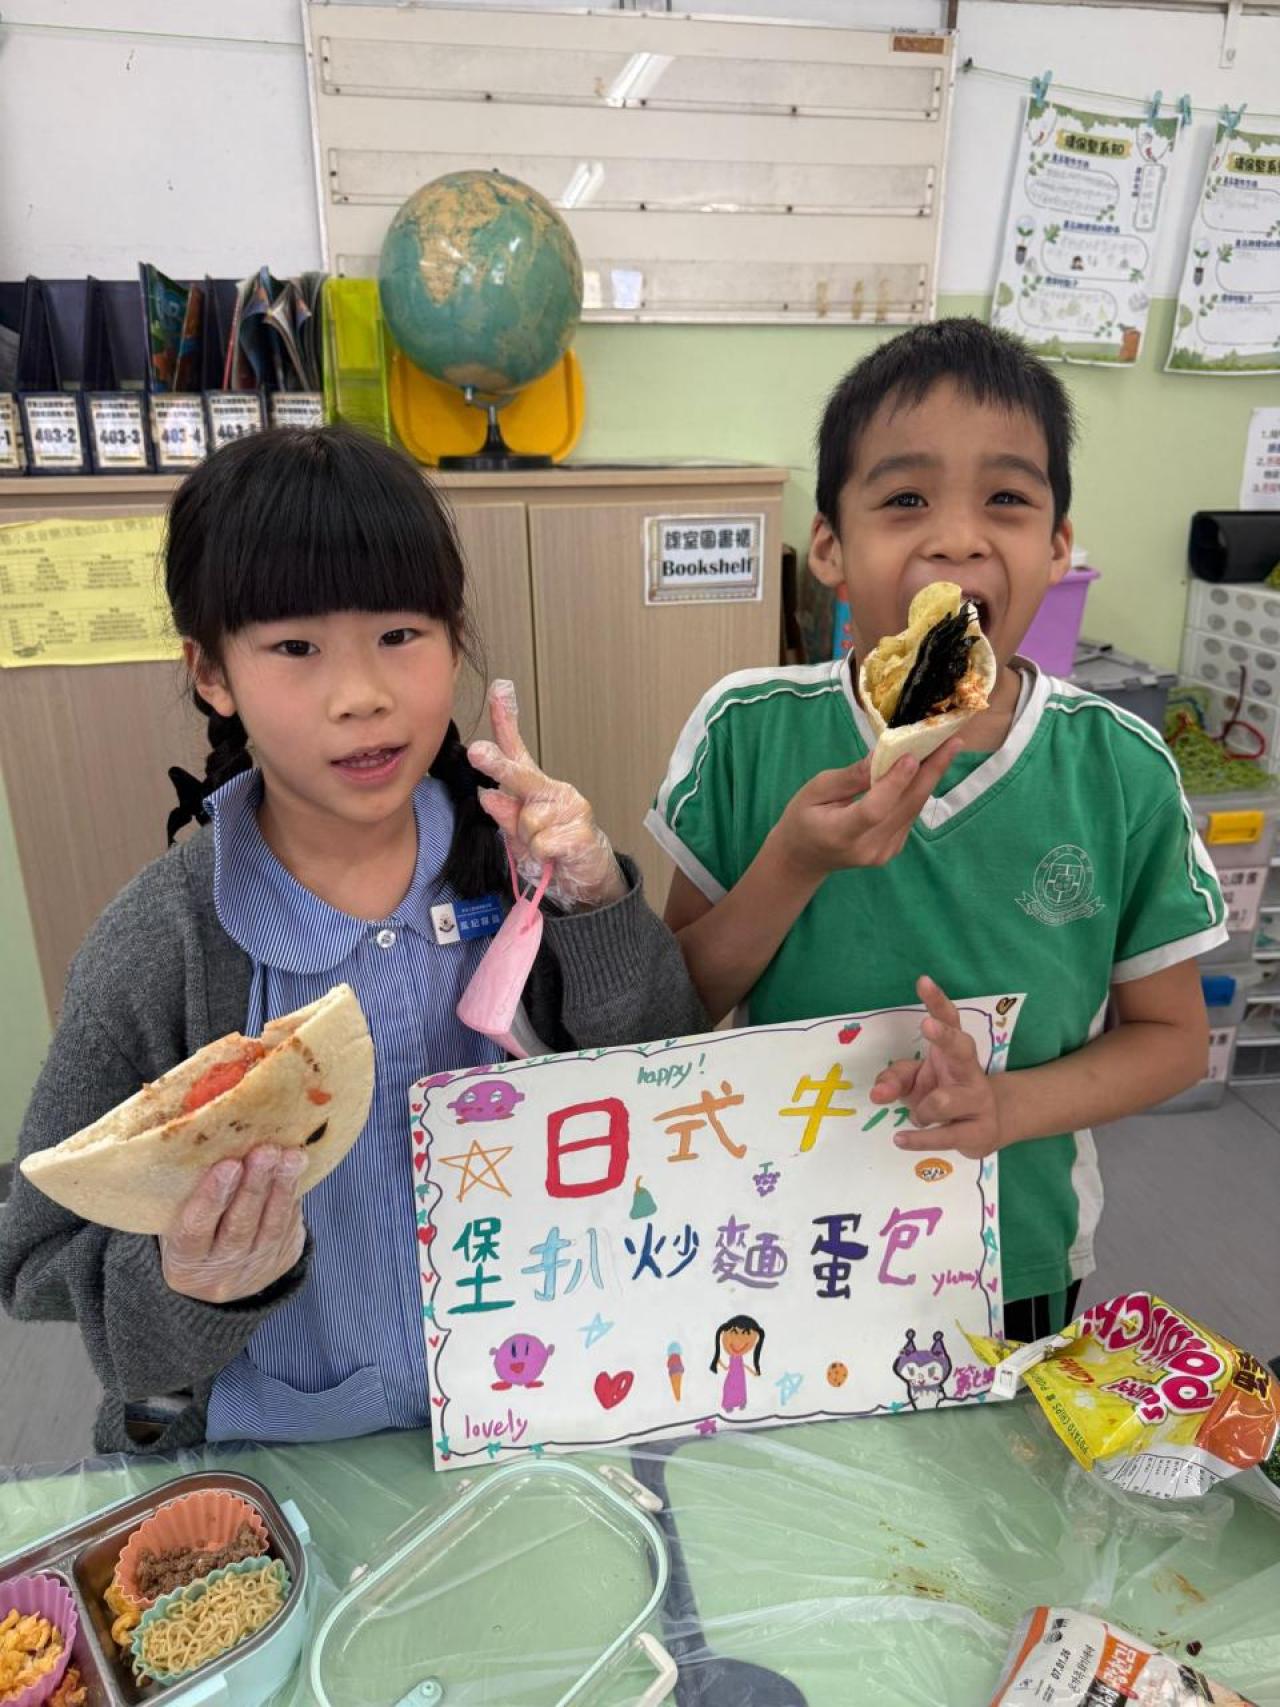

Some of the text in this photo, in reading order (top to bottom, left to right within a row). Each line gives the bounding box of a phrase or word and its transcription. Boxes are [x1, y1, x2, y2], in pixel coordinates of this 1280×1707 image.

[35, 428, 77, 443] 403-2
[100, 429, 141, 444] 403-3
[162, 428, 201, 444] 403-4
[663, 557, 753, 576] Bookshelf
[465, 1408, 528, 1442] lovely
